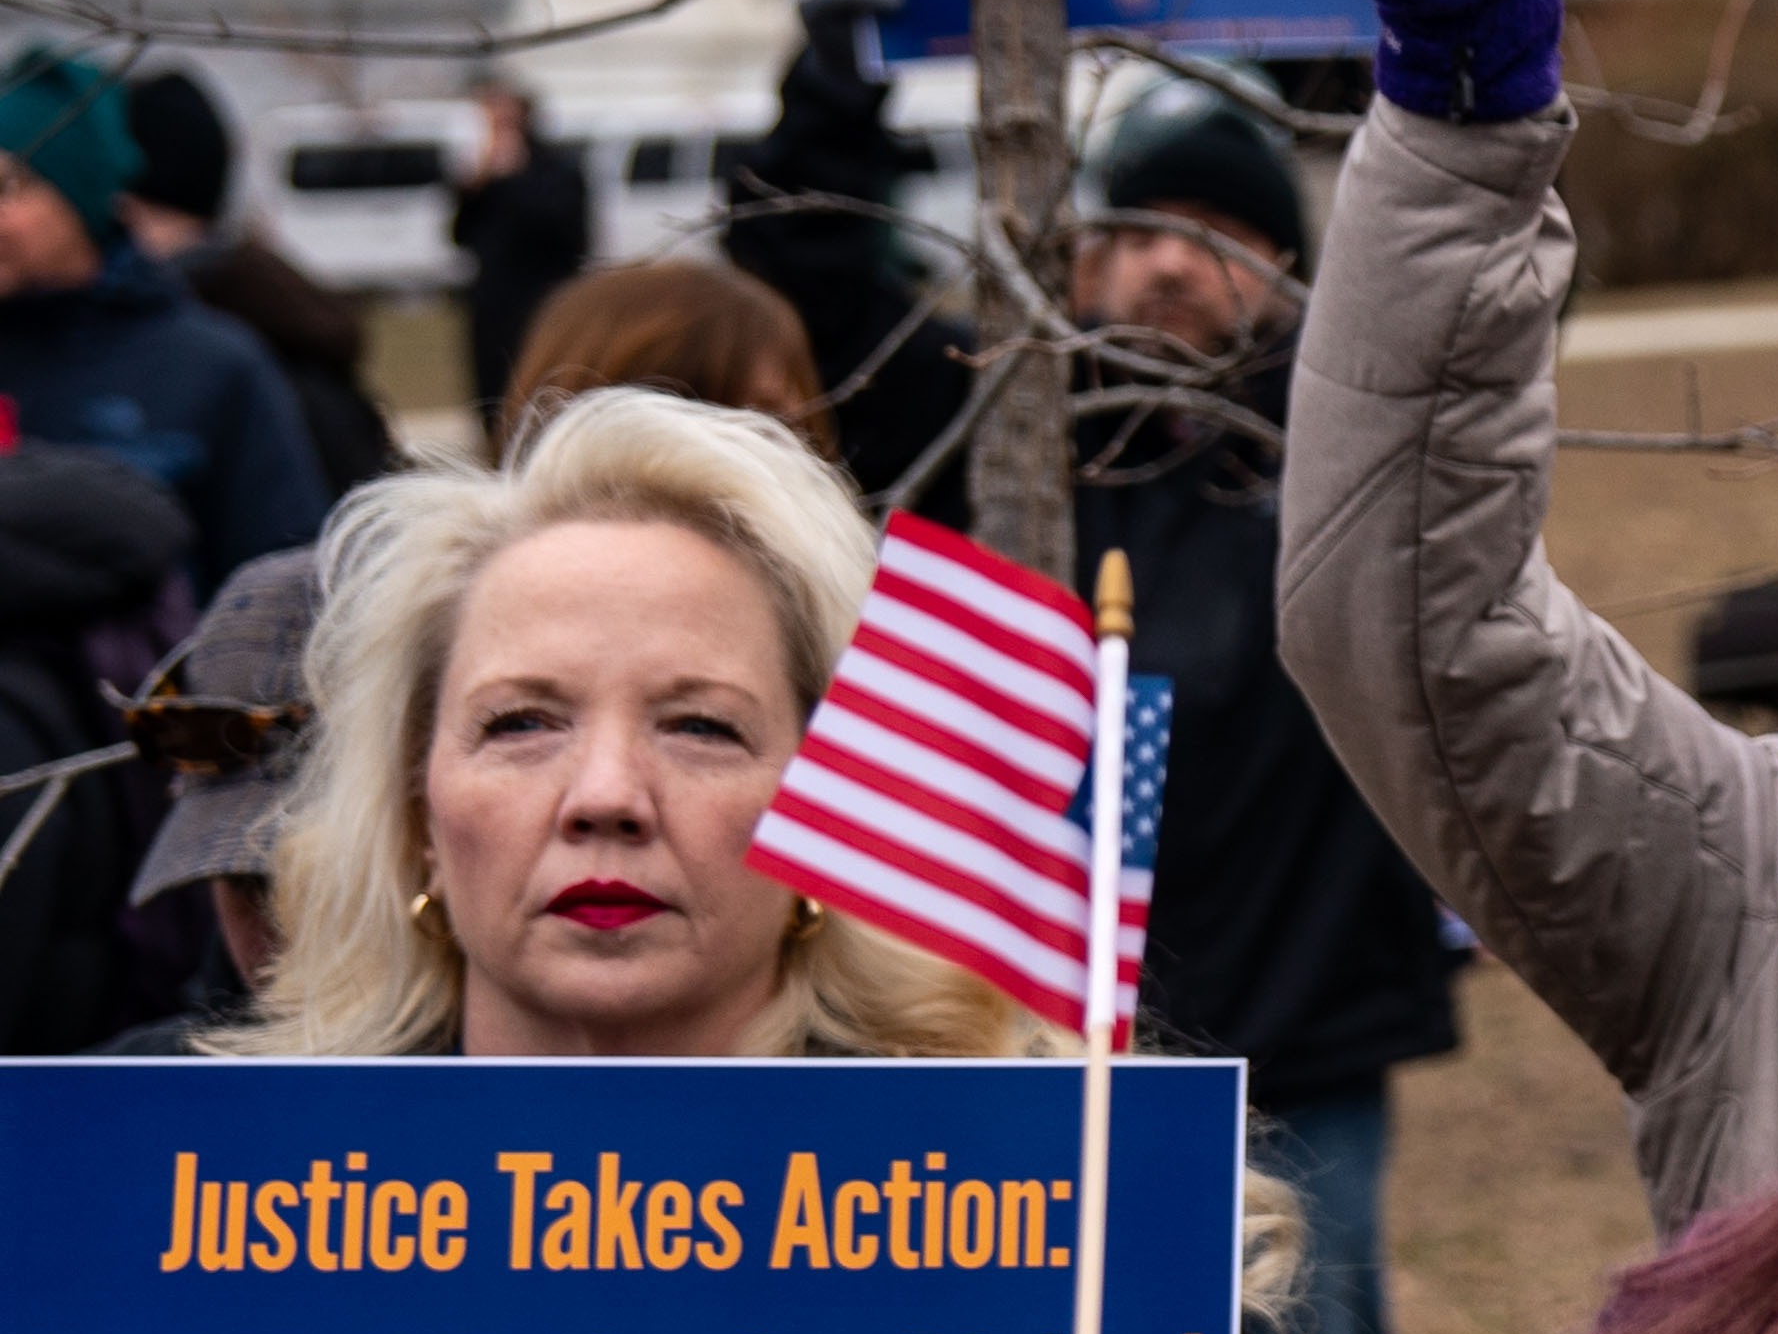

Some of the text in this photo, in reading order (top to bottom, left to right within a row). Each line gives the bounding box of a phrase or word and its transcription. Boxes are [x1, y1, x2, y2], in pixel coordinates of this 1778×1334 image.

[162, 1153, 1071, 1271] Justice Takes Action:
